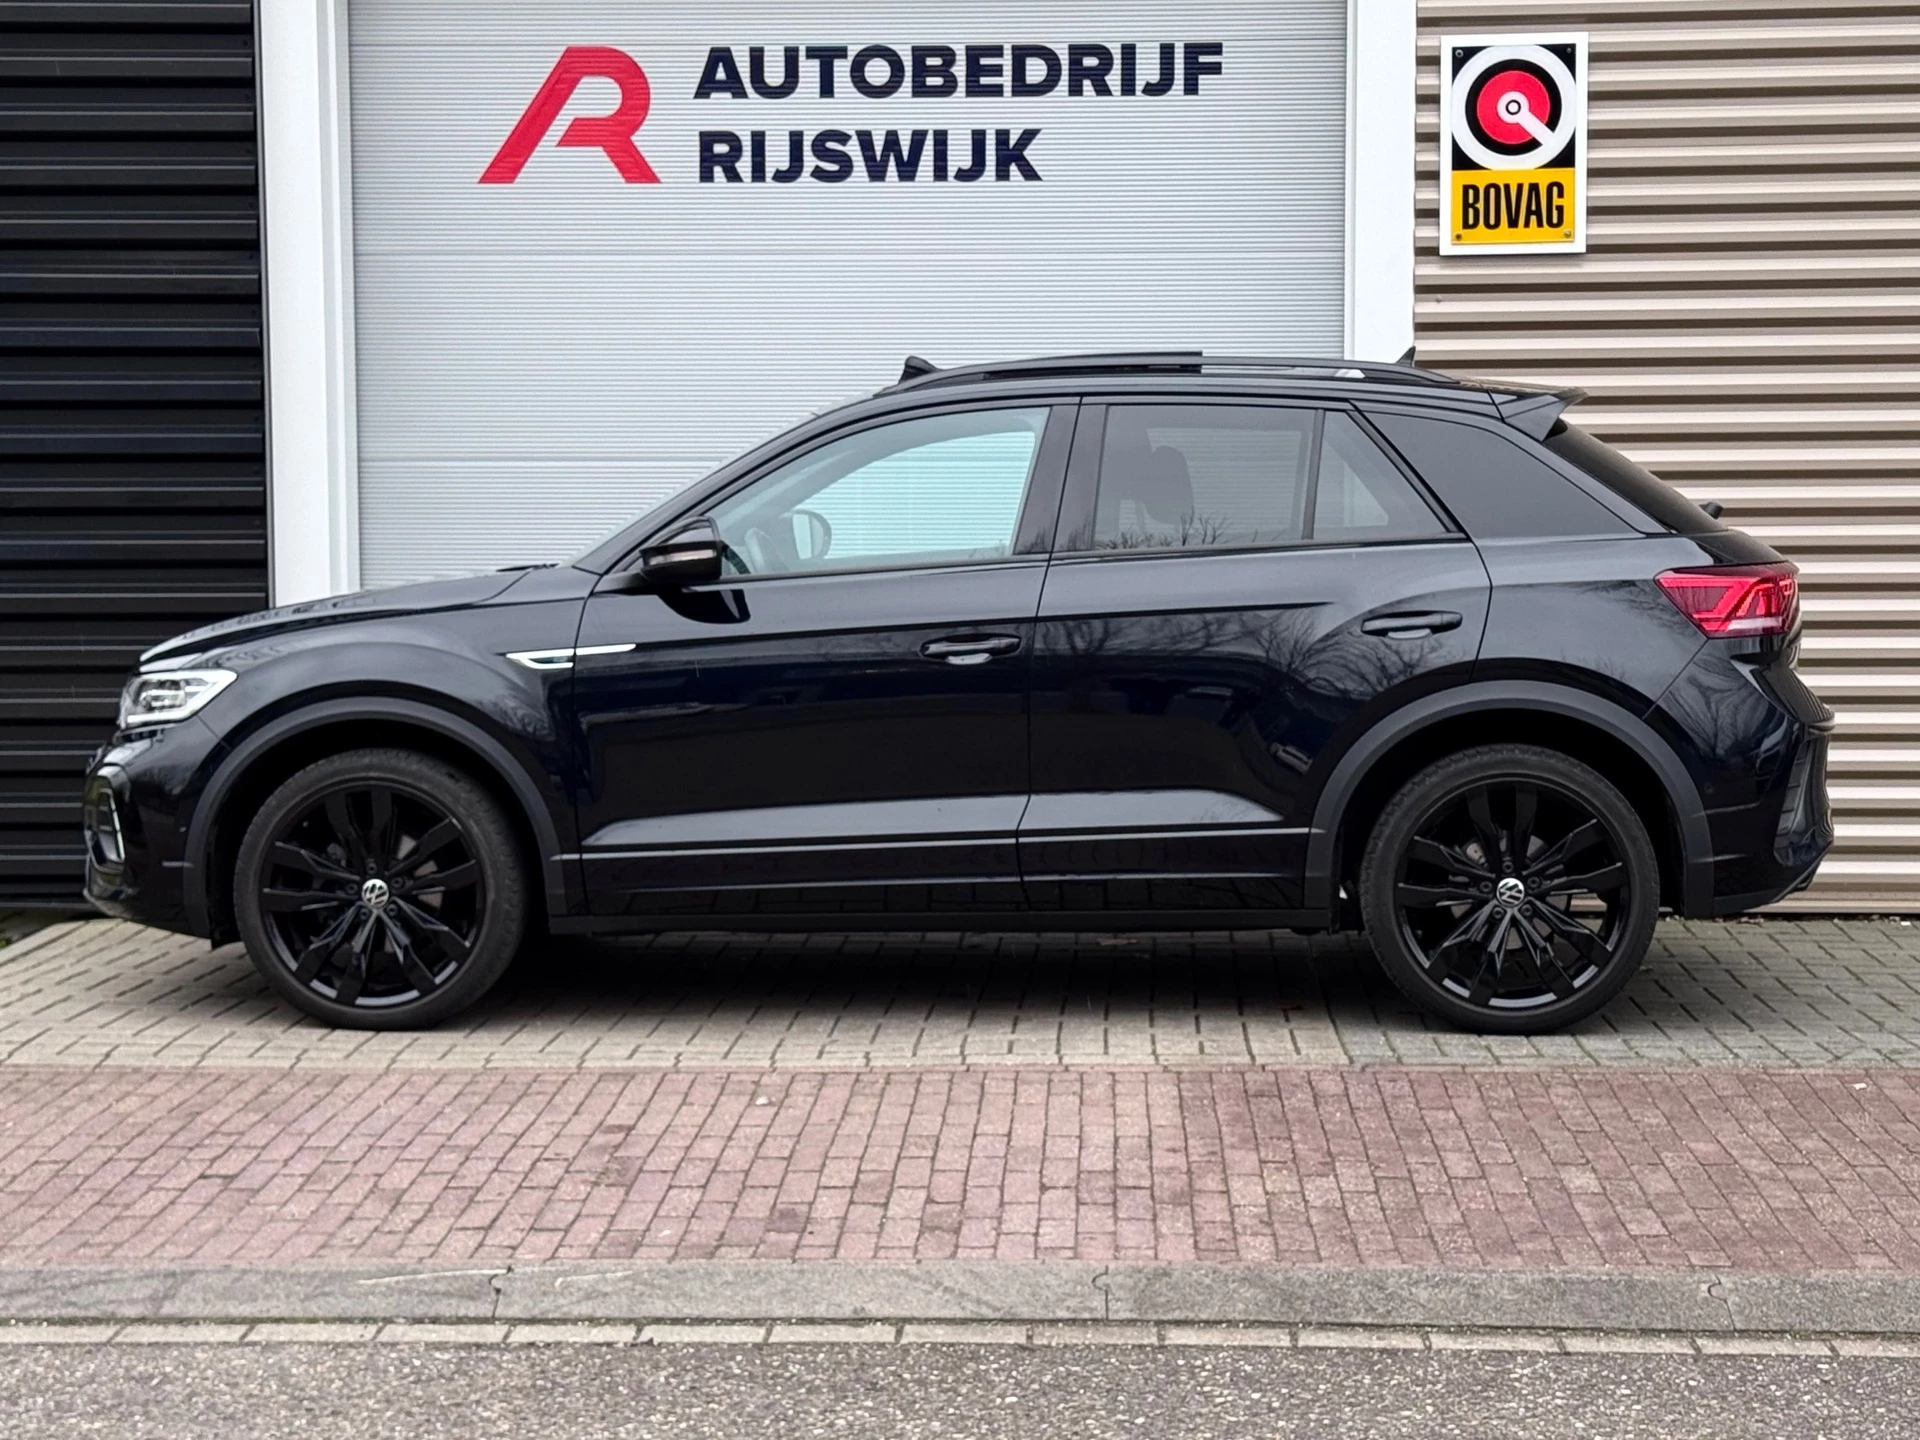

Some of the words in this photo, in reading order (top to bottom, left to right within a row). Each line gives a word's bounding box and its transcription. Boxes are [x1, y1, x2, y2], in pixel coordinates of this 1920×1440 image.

[693, 42, 1224, 100] AUTOBEDRIJF
[698, 128, 1043, 184] RIJSWIJK
[1462, 181, 1565, 230] BOVAG
